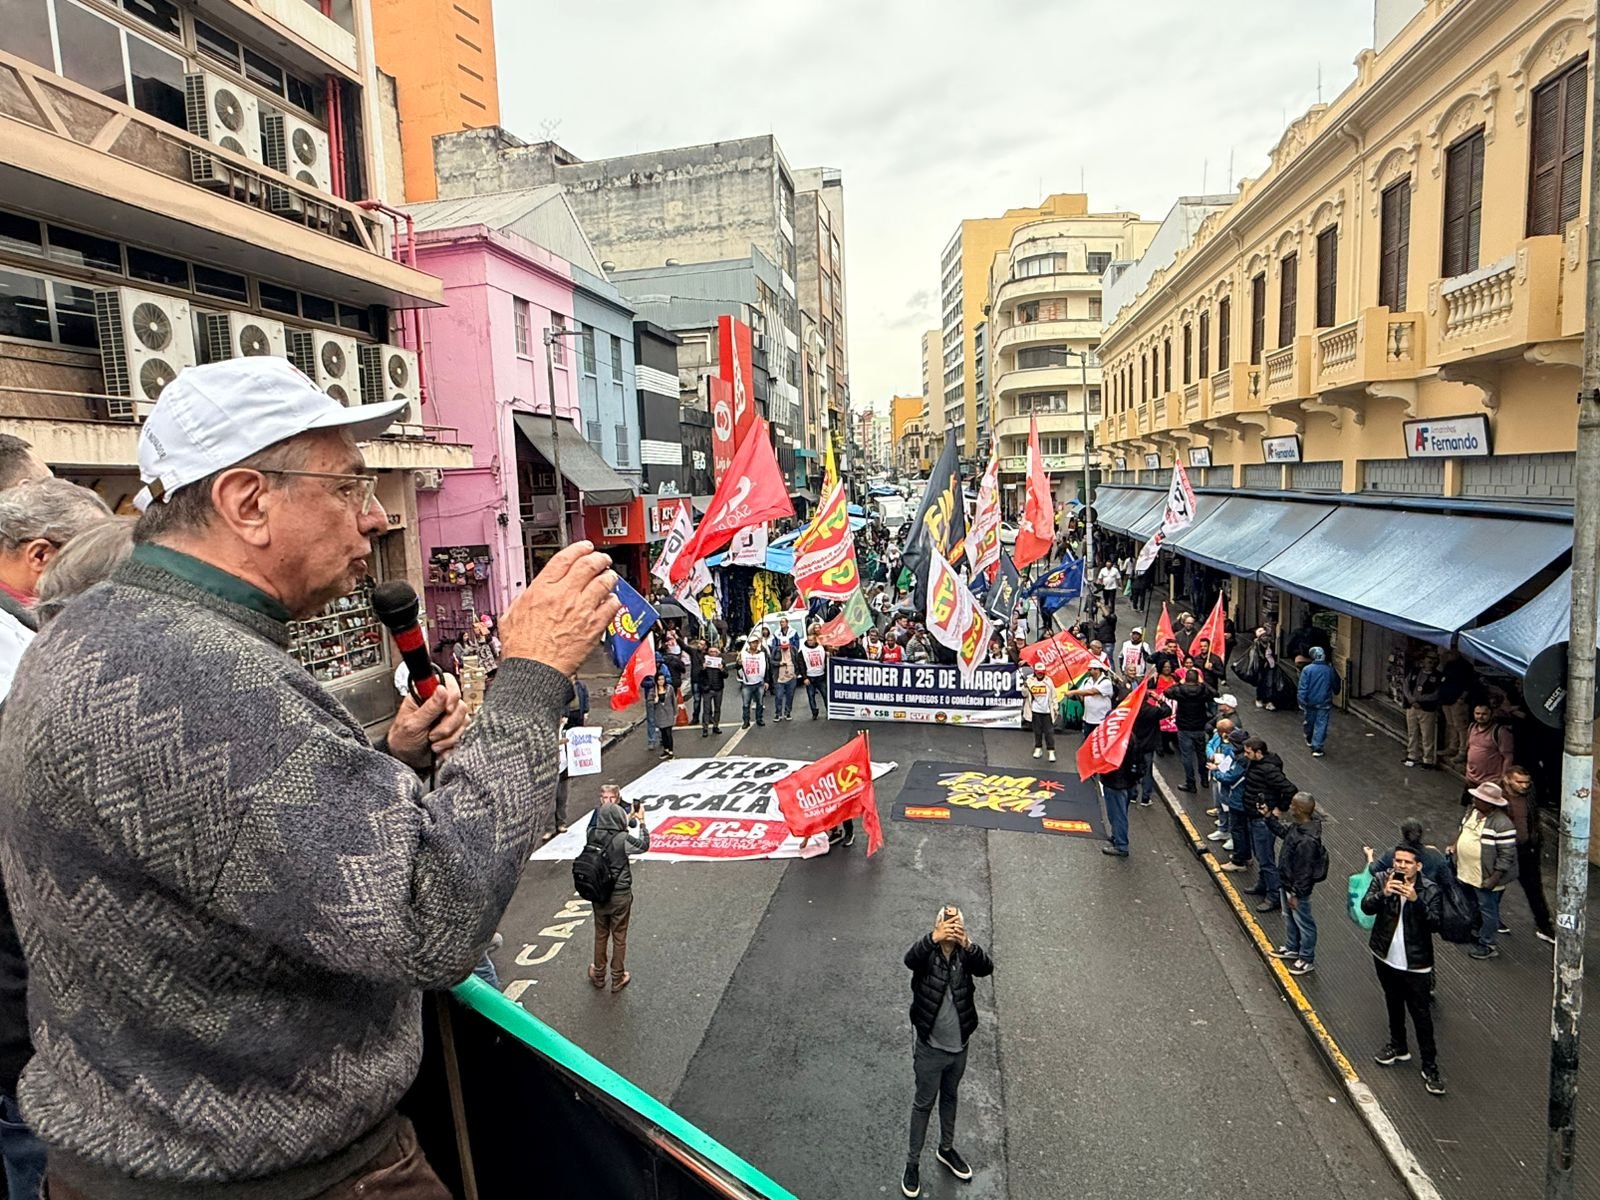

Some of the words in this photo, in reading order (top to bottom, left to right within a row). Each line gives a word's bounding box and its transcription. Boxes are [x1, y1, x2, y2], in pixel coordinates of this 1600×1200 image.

[1415, 427, 1430, 452] AF
[1431, 432, 1479, 451] Fernando
[1274, 446, 1296, 459] Fernando
[833, 665, 899, 687] DEFENDER
[902, 668, 912, 688] A
[915, 669, 935, 689] 25
[938, 669, 956, 689] DE
[960, 671, 1012, 697] MARÇO
[834, 690, 863, 701] DEFENDER
[864, 692, 895, 703] MILHARES
[896, 693, 904, 703] DE
[905, 694, 939, 705] EMPREGOS
[940, 695, 944, 705] E
[945, 695, 950, 705] O
[951, 694, 984, 706] COMÉRCIO
[726, 781, 775, 795] DA
[698, 821, 769, 841] PCdoB
